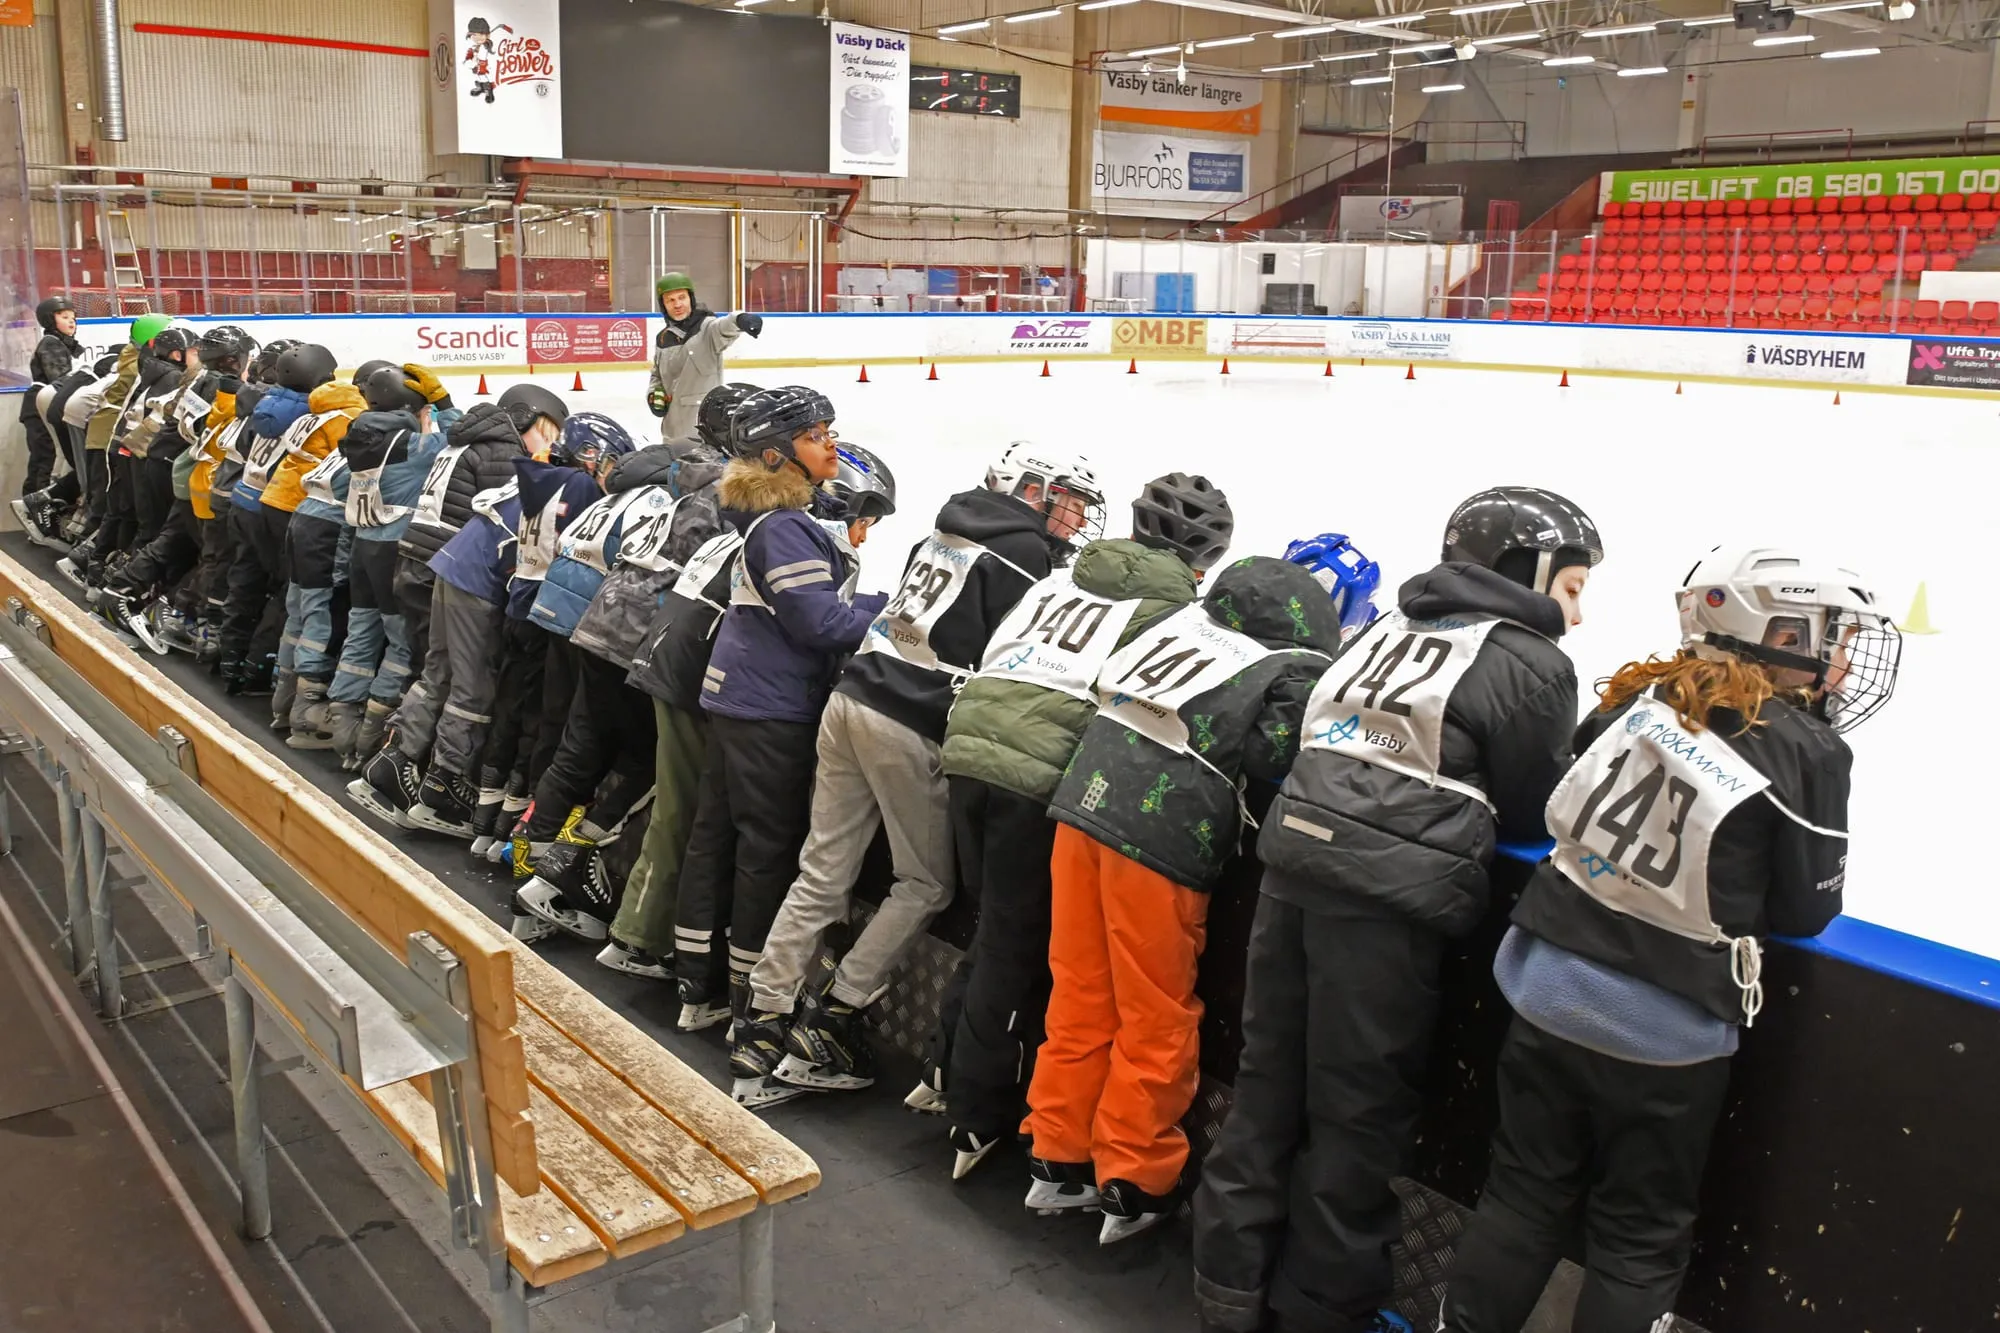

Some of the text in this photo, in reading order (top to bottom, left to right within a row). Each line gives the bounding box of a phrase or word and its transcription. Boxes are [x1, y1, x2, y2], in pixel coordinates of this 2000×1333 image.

[498, 37, 525, 57] Girl
[836, 33, 906, 51] Väsby Däck
[496, 50, 554, 86] power
[1107, 71, 1243, 106] Väsby tänker längre
[1094, 163, 1183, 191] BJURFORS
[1628, 177, 1759, 202] SWELIFT
[1776, 174, 1813, 199] 08
[1824, 172, 1883, 197] 580
[1896, 170, 1945, 195] 167
[417, 324, 519, 349] Scandic
[1138, 320, 1205, 345] MBF
[1421, 332, 1451, 343] LARM
[432, 353, 477, 362] UPPLANDS
[1761, 345, 1866, 370] VÄSBYHEM
[1946, 345, 1975, 357] Uffe
[1027, 457, 1054, 471] CCM
[1780, 586, 1817, 595] CCM
[1016, 593, 1114, 654] 140
[1115, 636, 1217, 701] 141
[1333, 632, 1453, 718] 142
[1364, 728, 1408, 754] Väsby
[1569, 748, 1698, 889] 143
